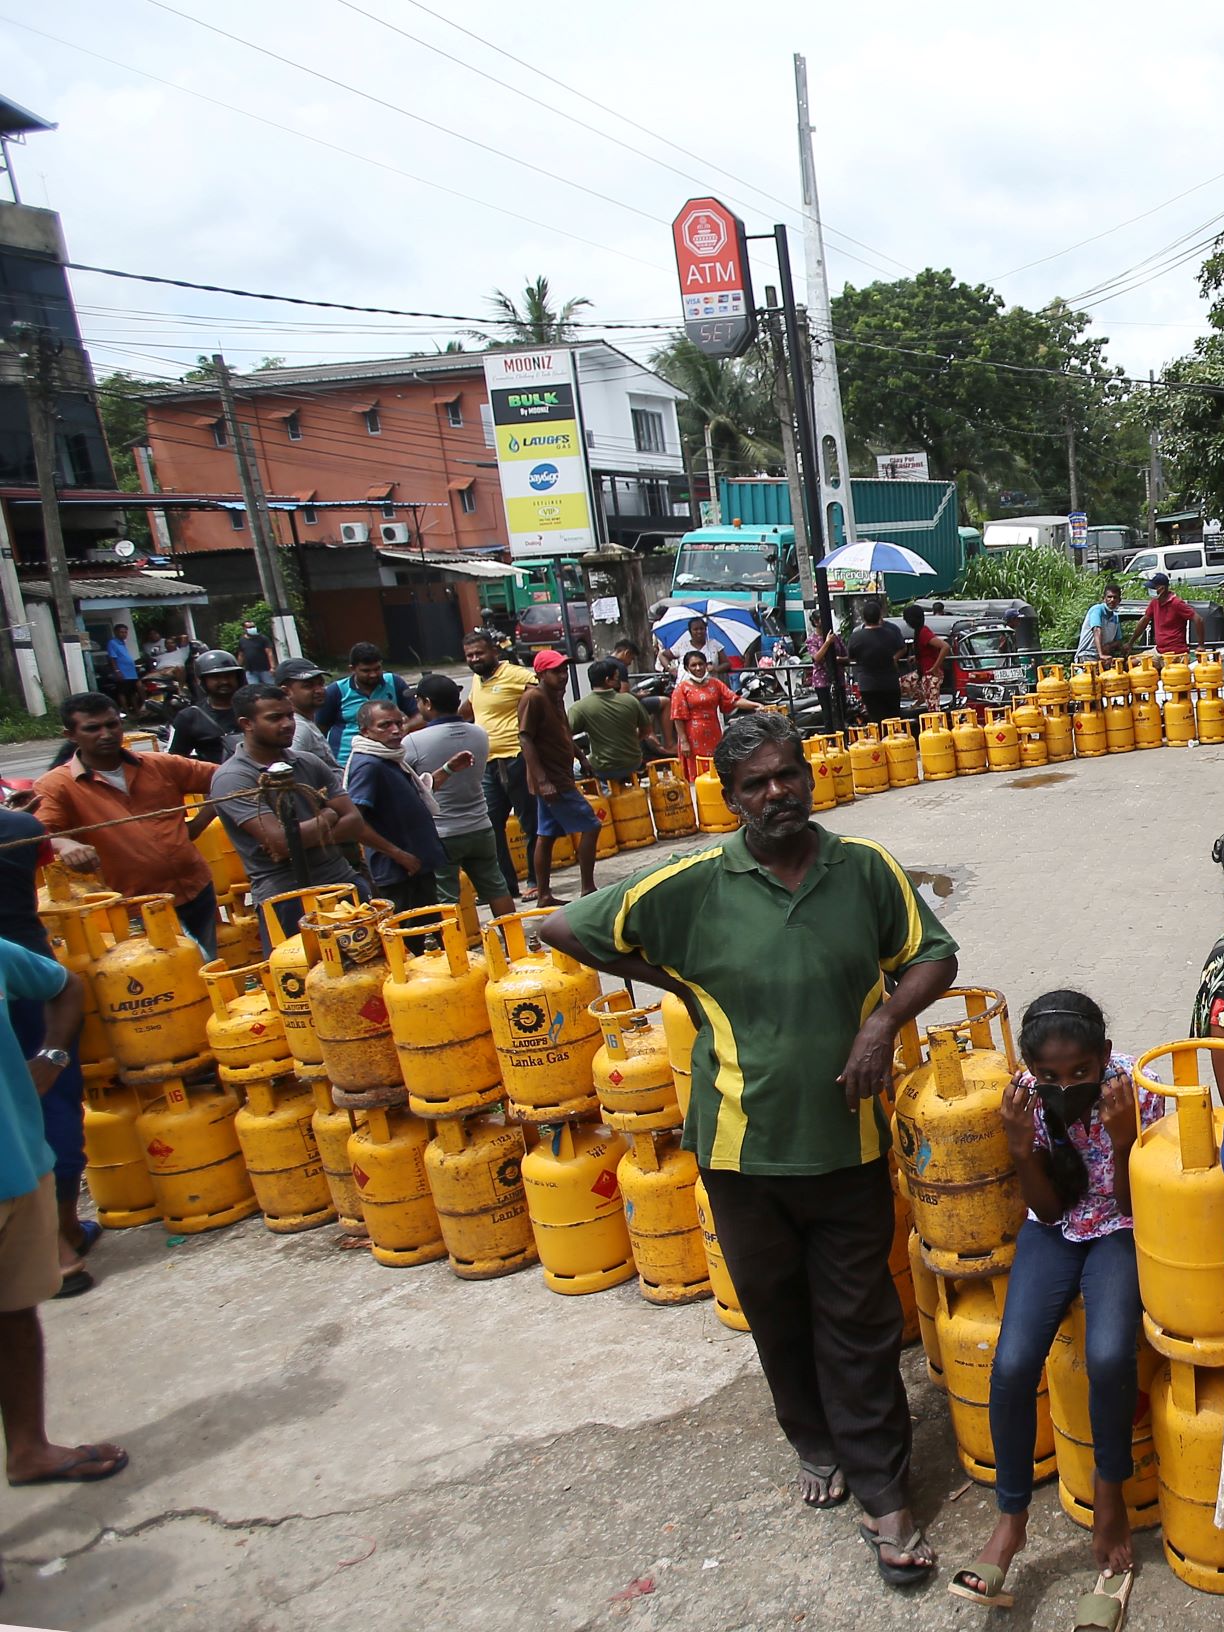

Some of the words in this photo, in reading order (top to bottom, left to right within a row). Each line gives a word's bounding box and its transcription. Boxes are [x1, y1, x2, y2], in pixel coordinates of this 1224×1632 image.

[686, 261, 736, 286] ATM
[700, 322, 735, 343] SET
[504, 355, 553, 373] MOONIZ
[508, 392, 560, 408] BULK
[523, 434, 571, 447] LAUGFS
[110, 991, 175, 1012] LAUGFS
[131, 1006, 154, 1016] GAS
[512, 1037, 548, 1048] LAUGFS
[509, 1055, 544, 1067] Lanka
[546, 1051, 570, 1064] Gas
[168, 1089, 184, 1103] 16
